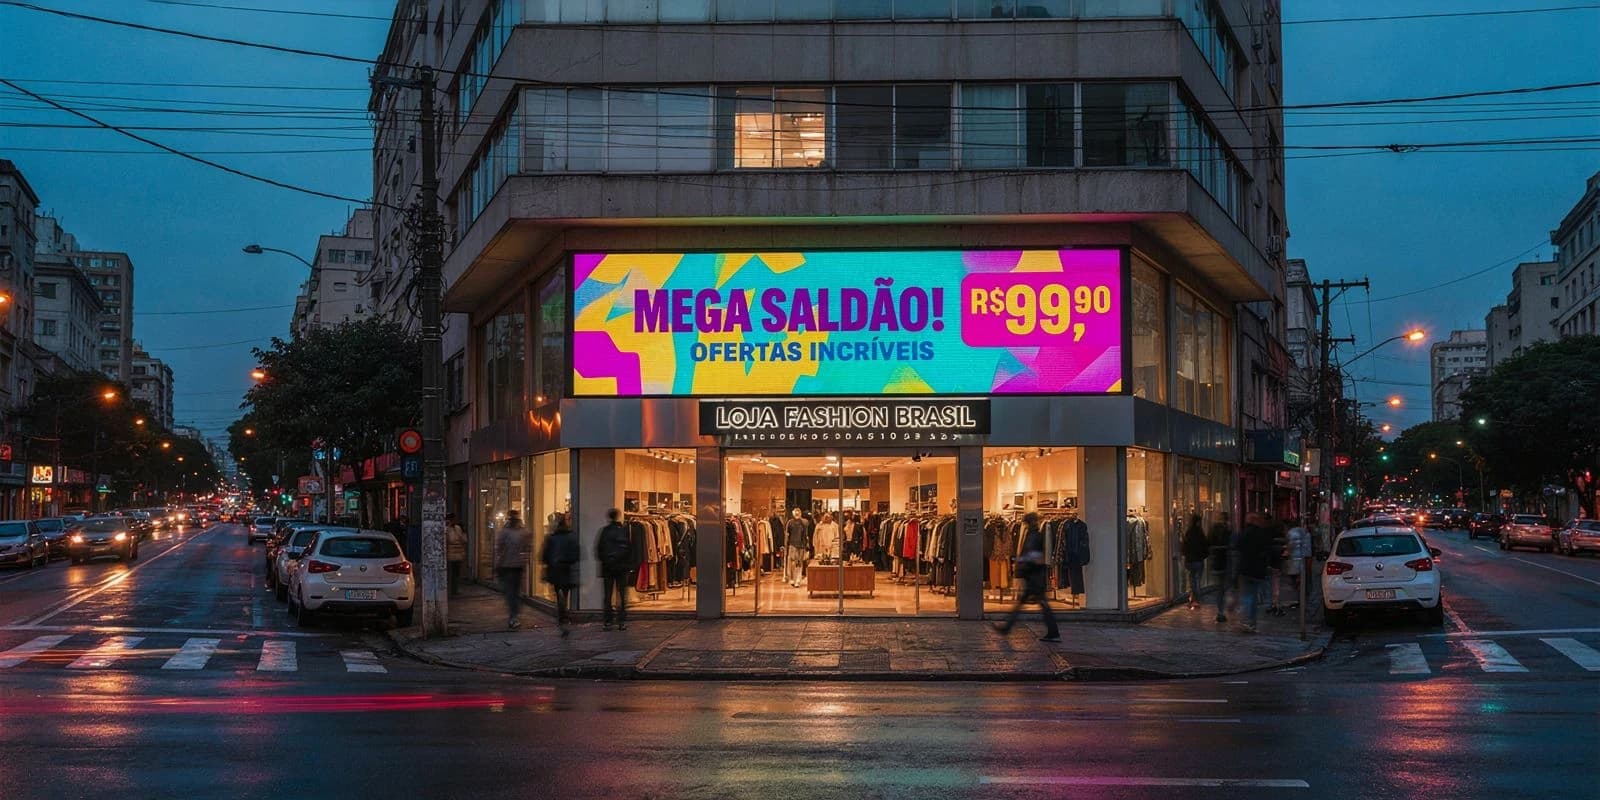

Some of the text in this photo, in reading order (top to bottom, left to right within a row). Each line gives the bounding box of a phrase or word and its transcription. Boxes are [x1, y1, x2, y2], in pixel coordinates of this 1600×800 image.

[634, 277, 944, 333] MEGA SALDÃO!
[690, 338, 935, 362] OFERTAS INCRÍVEIS
[716, 405, 977, 428] LOJA FASHION BRASIL
